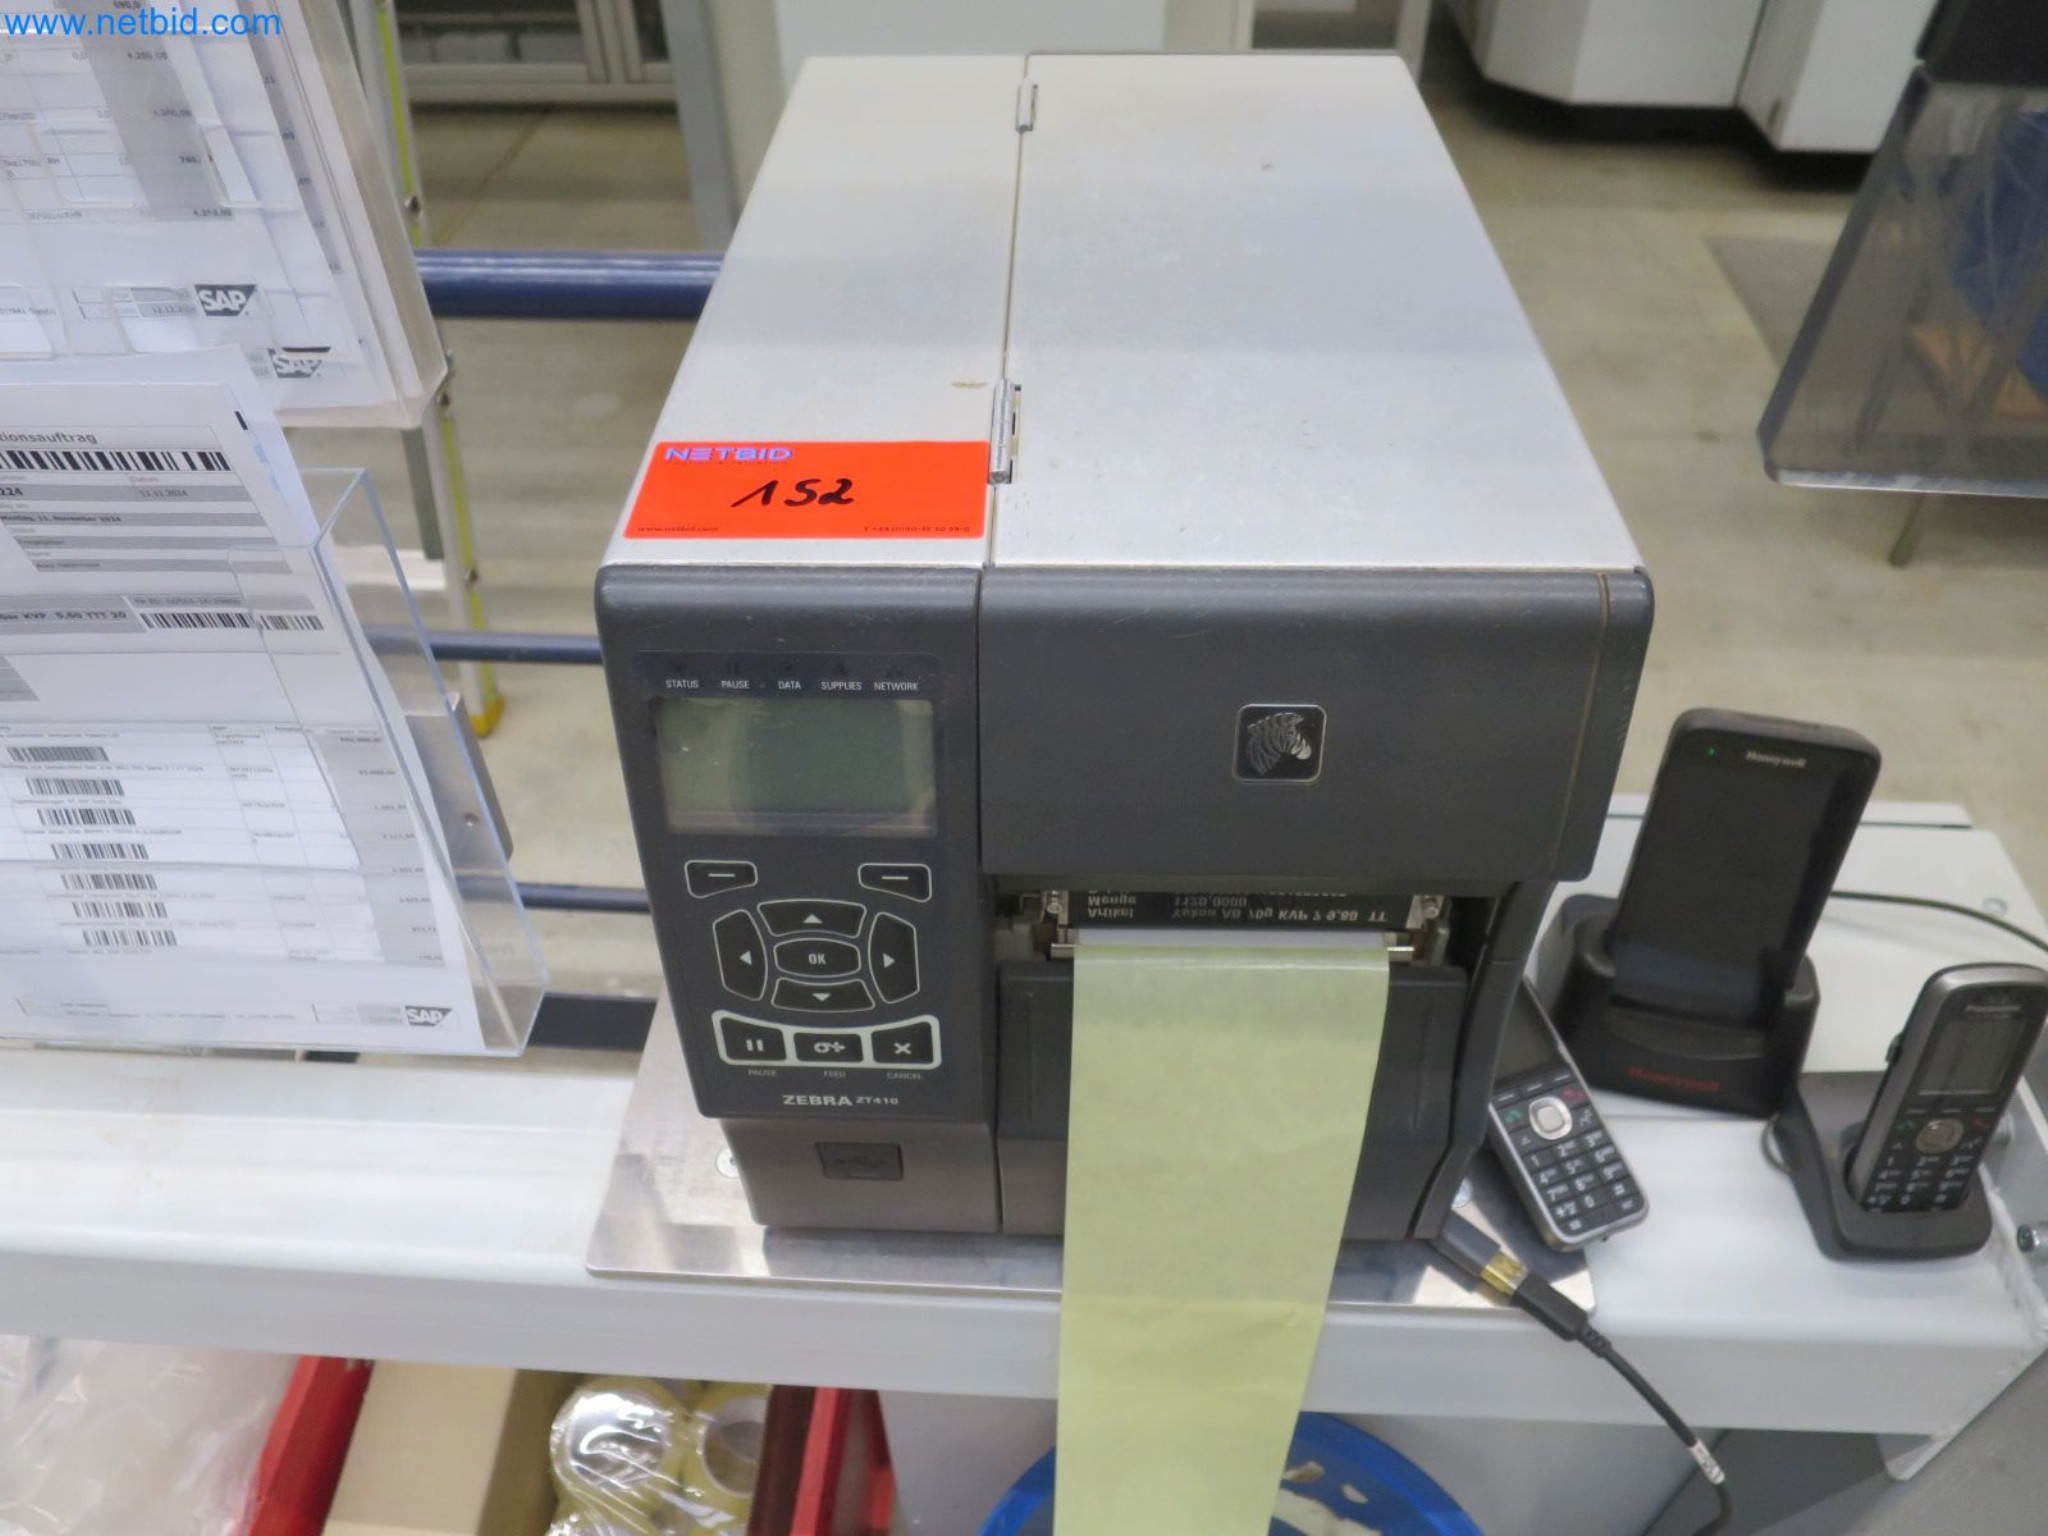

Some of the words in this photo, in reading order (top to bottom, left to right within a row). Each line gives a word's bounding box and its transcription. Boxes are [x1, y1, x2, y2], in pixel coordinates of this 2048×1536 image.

[197, 287, 249, 314] SAP
[664, 446, 793, 462] NETBID
[730, 477, 854, 508] 152
[665, 680, 699, 689] STATUS
[721, 680, 750, 690] PAUSE
[778, 681, 801, 690] DATA
[820, 681, 862, 691] SUPPLIES
[873, 682, 919, 691] NETWORK
[1746, 750, 1807, 769] Honeywell
[807, 953, 827, 965] OK
[405, 1008, 446, 1024] SAP
[782, 1095, 853, 1107] ZEBRA
